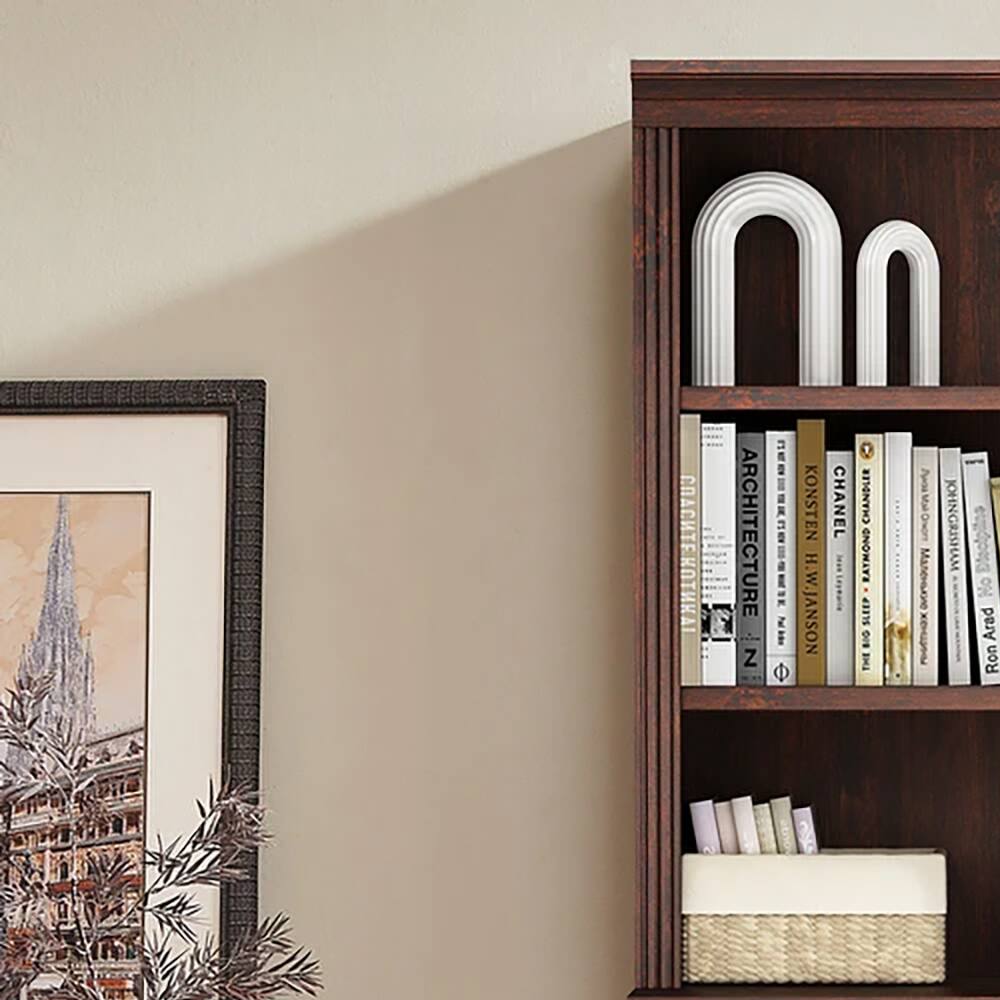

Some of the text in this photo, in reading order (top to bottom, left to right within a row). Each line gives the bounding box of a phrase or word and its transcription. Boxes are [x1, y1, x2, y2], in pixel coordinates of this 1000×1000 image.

[742, 447, 758, 617] ARCHITECTURE
[805, 463, 818, 541] KONSTEN
[833, 465, 846, 538] CHANEL
[862, 468, 870, 671] THE BIG SLEEP RAYMOND CHANDLER
[981, 606, 997, 641] Arad
[984, 645, 1000, 675] Ron
